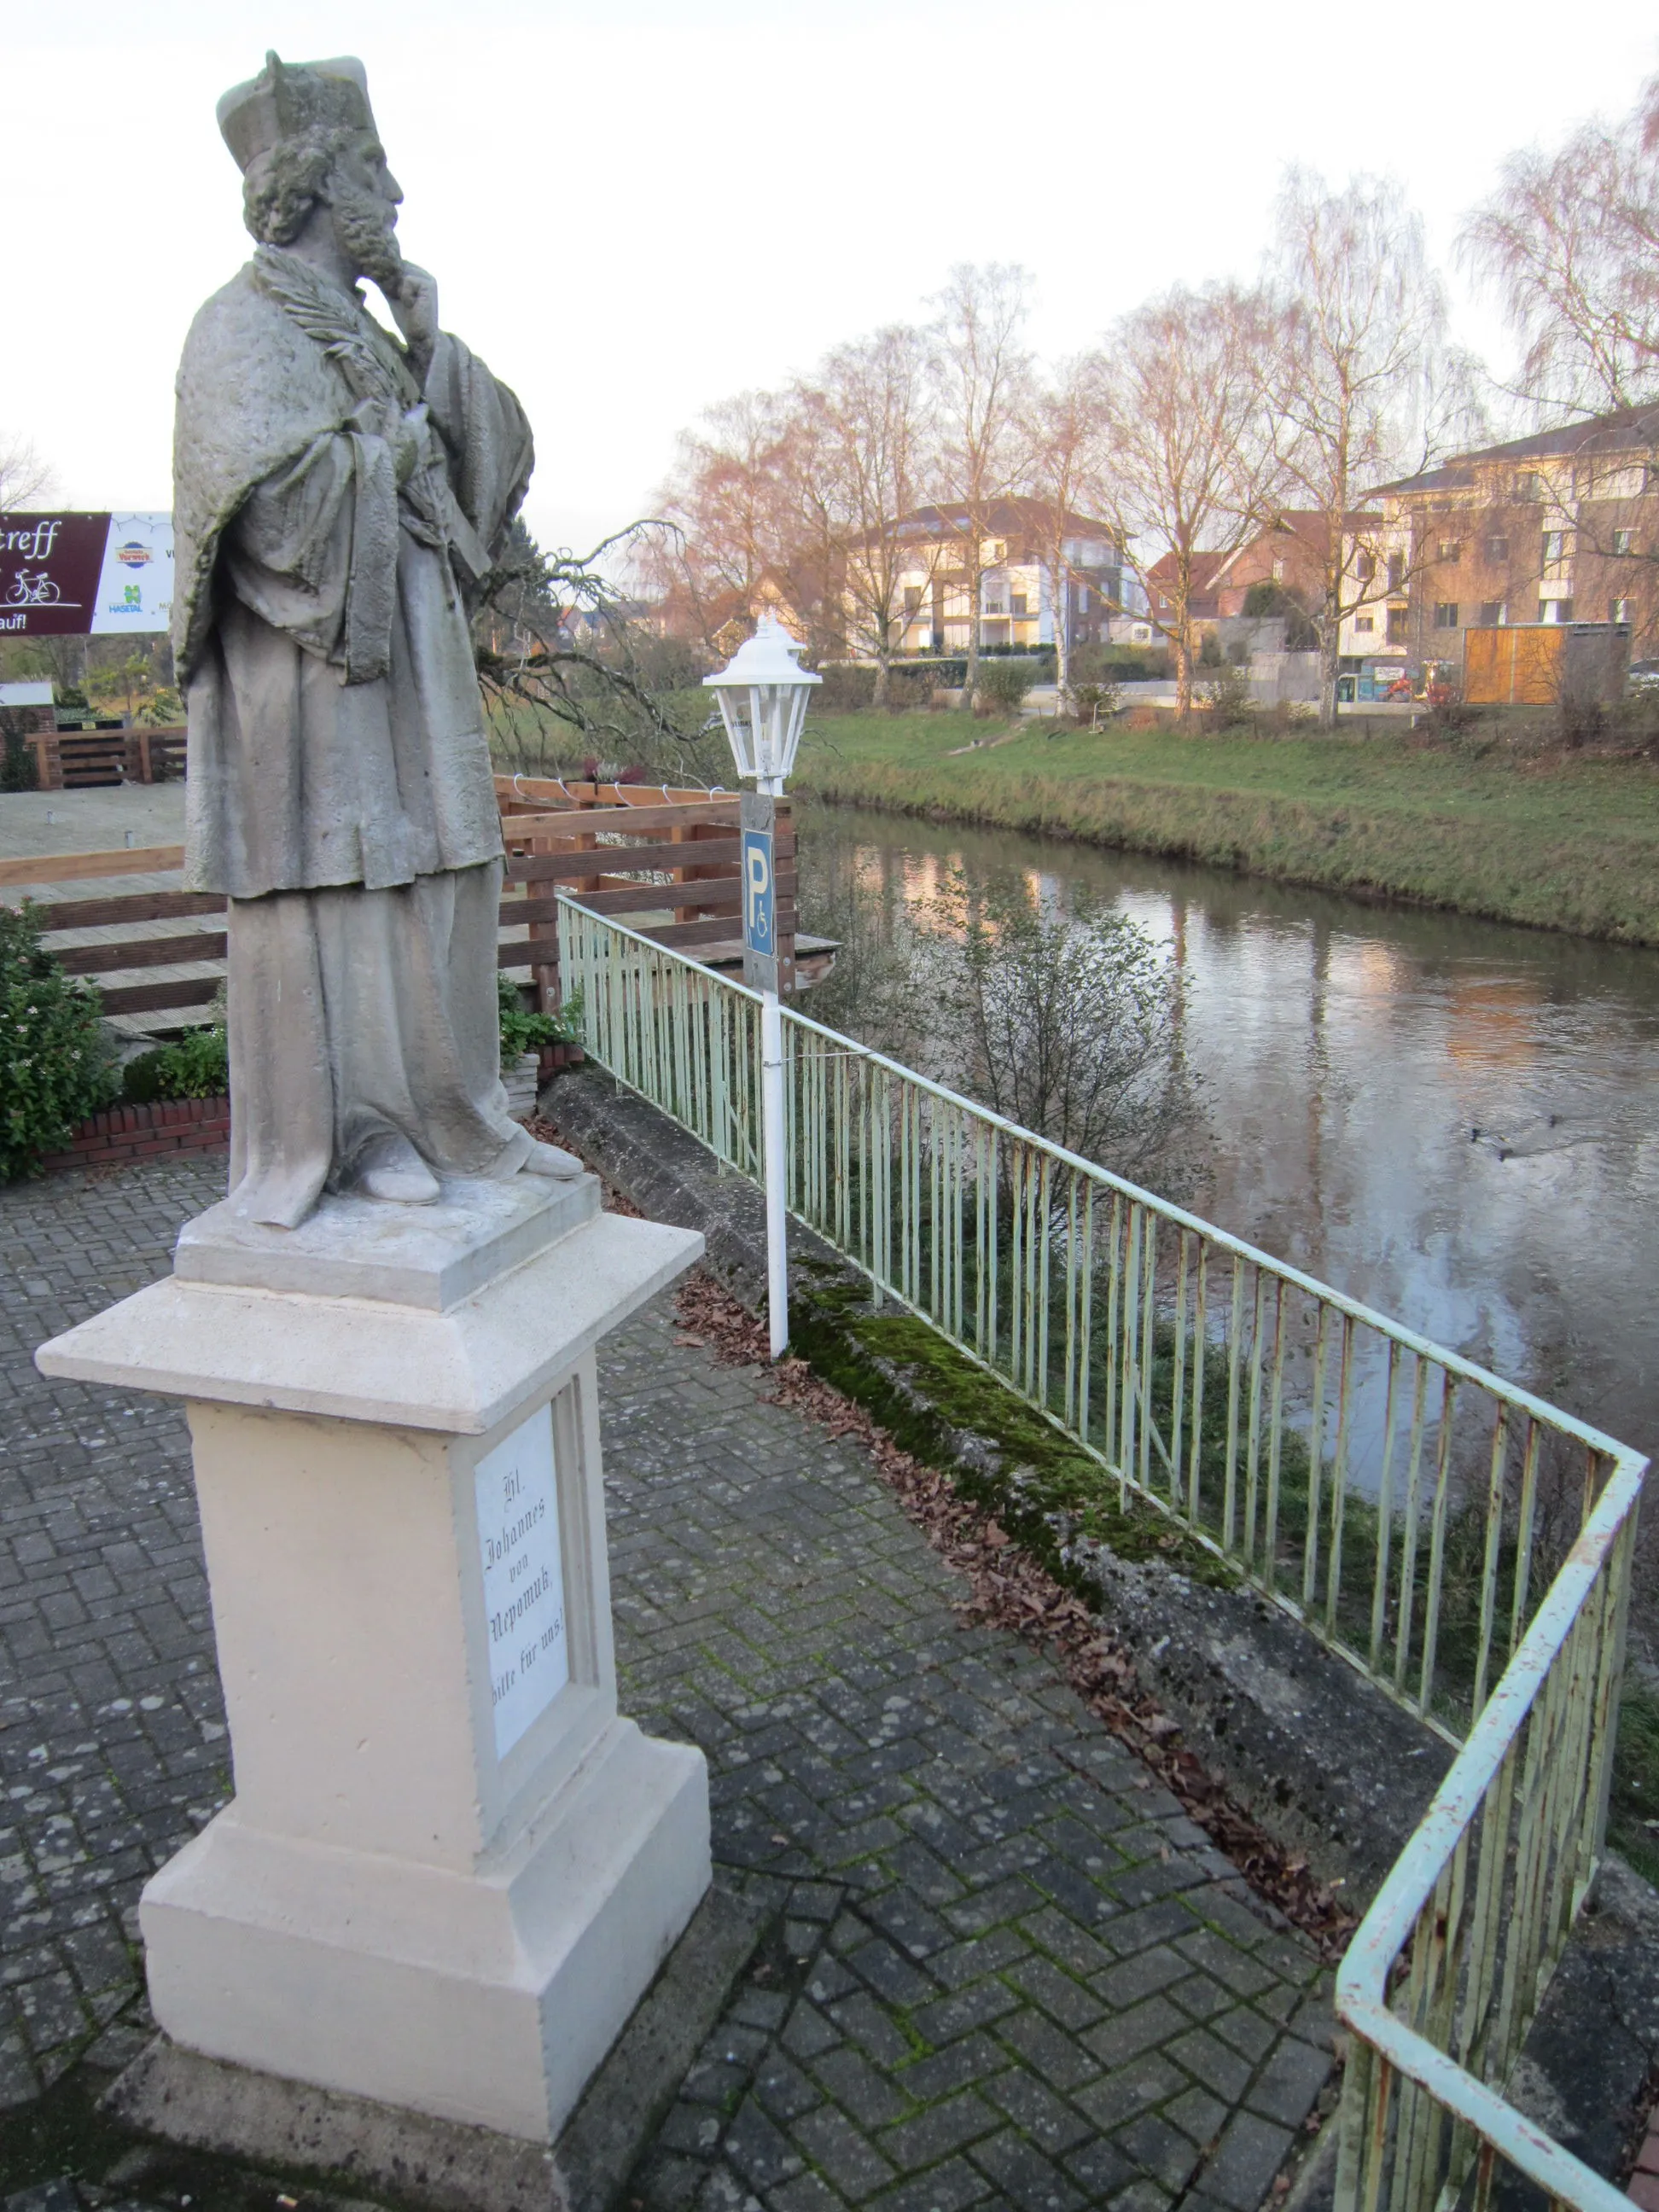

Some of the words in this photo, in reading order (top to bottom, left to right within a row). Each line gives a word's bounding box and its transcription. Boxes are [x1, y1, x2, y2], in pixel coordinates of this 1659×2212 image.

[0, 614, 26, 629] auf!
[108, 604, 143, 613] HASETAL
[748, 847, 768, 928] P
[486, 1499, 545, 1575] Johannes
[509, 1554, 528, 1582] von
[491, 1669, 515, 1706] bitte
[520, 1642, 537, 1674] für
[541, 1608, 563, 1650] uns!
